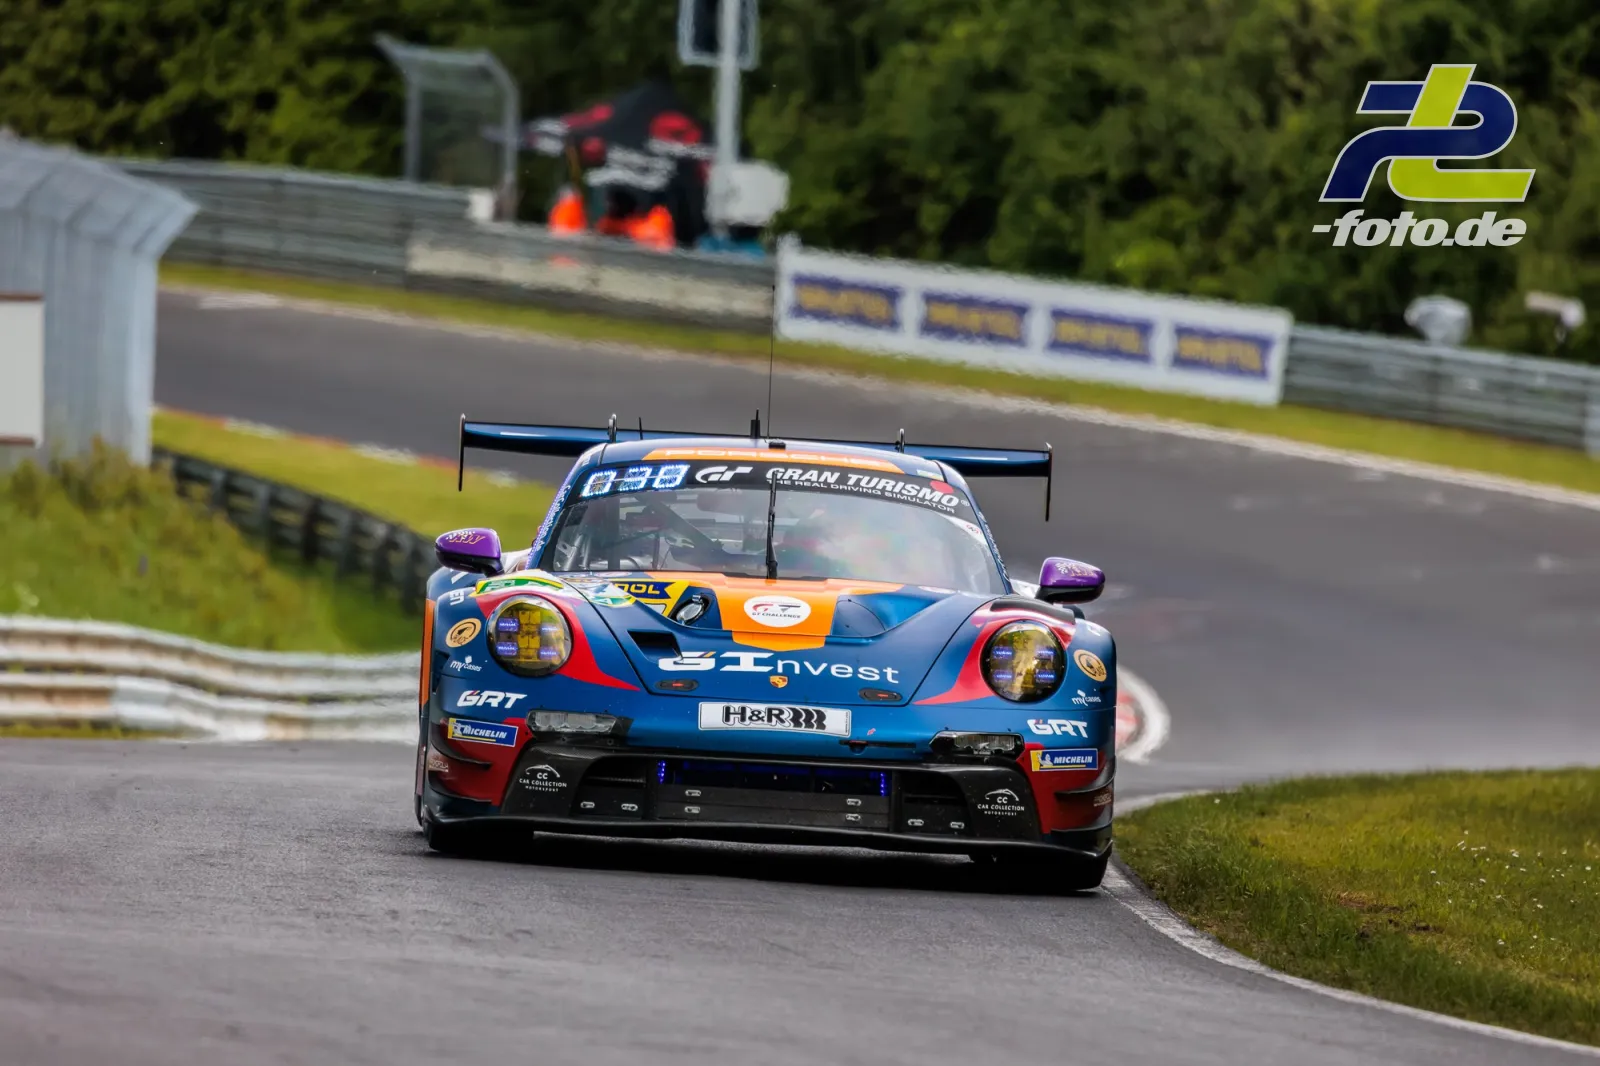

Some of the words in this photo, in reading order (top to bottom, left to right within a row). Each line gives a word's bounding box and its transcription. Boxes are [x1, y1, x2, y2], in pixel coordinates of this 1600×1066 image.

[581, 464, 691, 497] 038
[765, 467, 841, 484] GRAN
[846, 473, 960, 507] TURISMO
[794, 480, 828, 489] REAL
[830, 484, 882, 496] DRIVING
[884, 492, 956, 515] SIMULATOR
[457, 690, 528, 709] GRT
[722, 704, 792, 727] H&R
[463, 725, 508, 739] MICHELIN
[1027, 719, 1088, 738] GRT
[1053, 755, 1093, 764] MICHELIN
[531, 780, 567, 788] COLLECTION
[536, 772, 548, 780] CC
[996, 796, 1008, 804] CC
